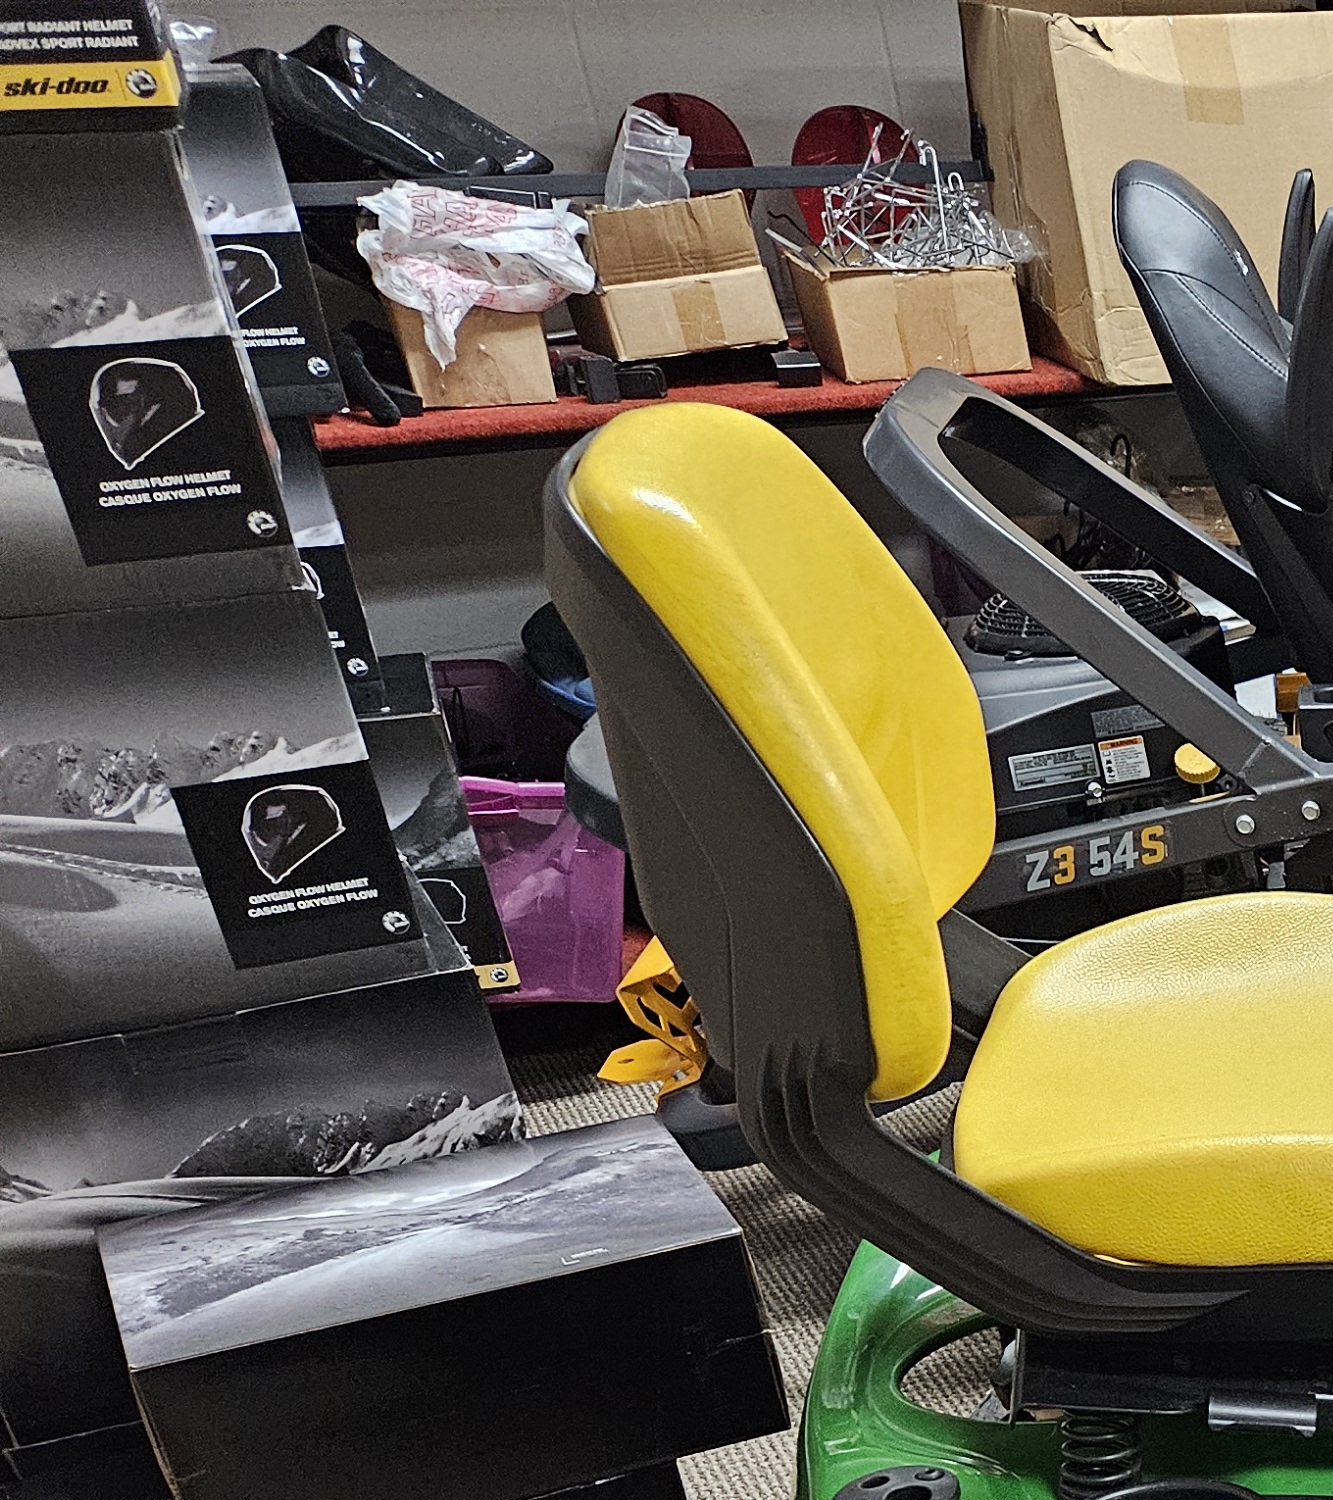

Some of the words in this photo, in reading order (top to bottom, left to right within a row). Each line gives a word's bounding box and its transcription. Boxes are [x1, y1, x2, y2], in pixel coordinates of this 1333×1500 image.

[27, 21, 82, 32] RADIANT
[83, 19, 133, 31] HELMET
[41, 37, 83, 49] SPORT
[84, 36, 139, 48] RADIANT
[3, 77, 109, 96] ski-doo
[99, 478, 150, 492] OXYGEN
[150, 474, 184, 488] FLOW
[184, 470, 231, 484] HELMET
[99, 493, 152, 507] CASQUE
[152, 488, 206, 502] OXYGEN
[207, 484, 242, 497] FLOW
[1025, 845, 1076, 892] Z3
[1089, 825, 1166, 877] 54S
[248, 890, 295, 905] OXYGEN
[295, 885, 325, 897] FLOW
[325, 877, 369, 892] HELMET
[248, 902, 296, 918] CASQUE
[297, 894, 345, 909] OXYGEN
[345, 889, 378, 901] FLOW
